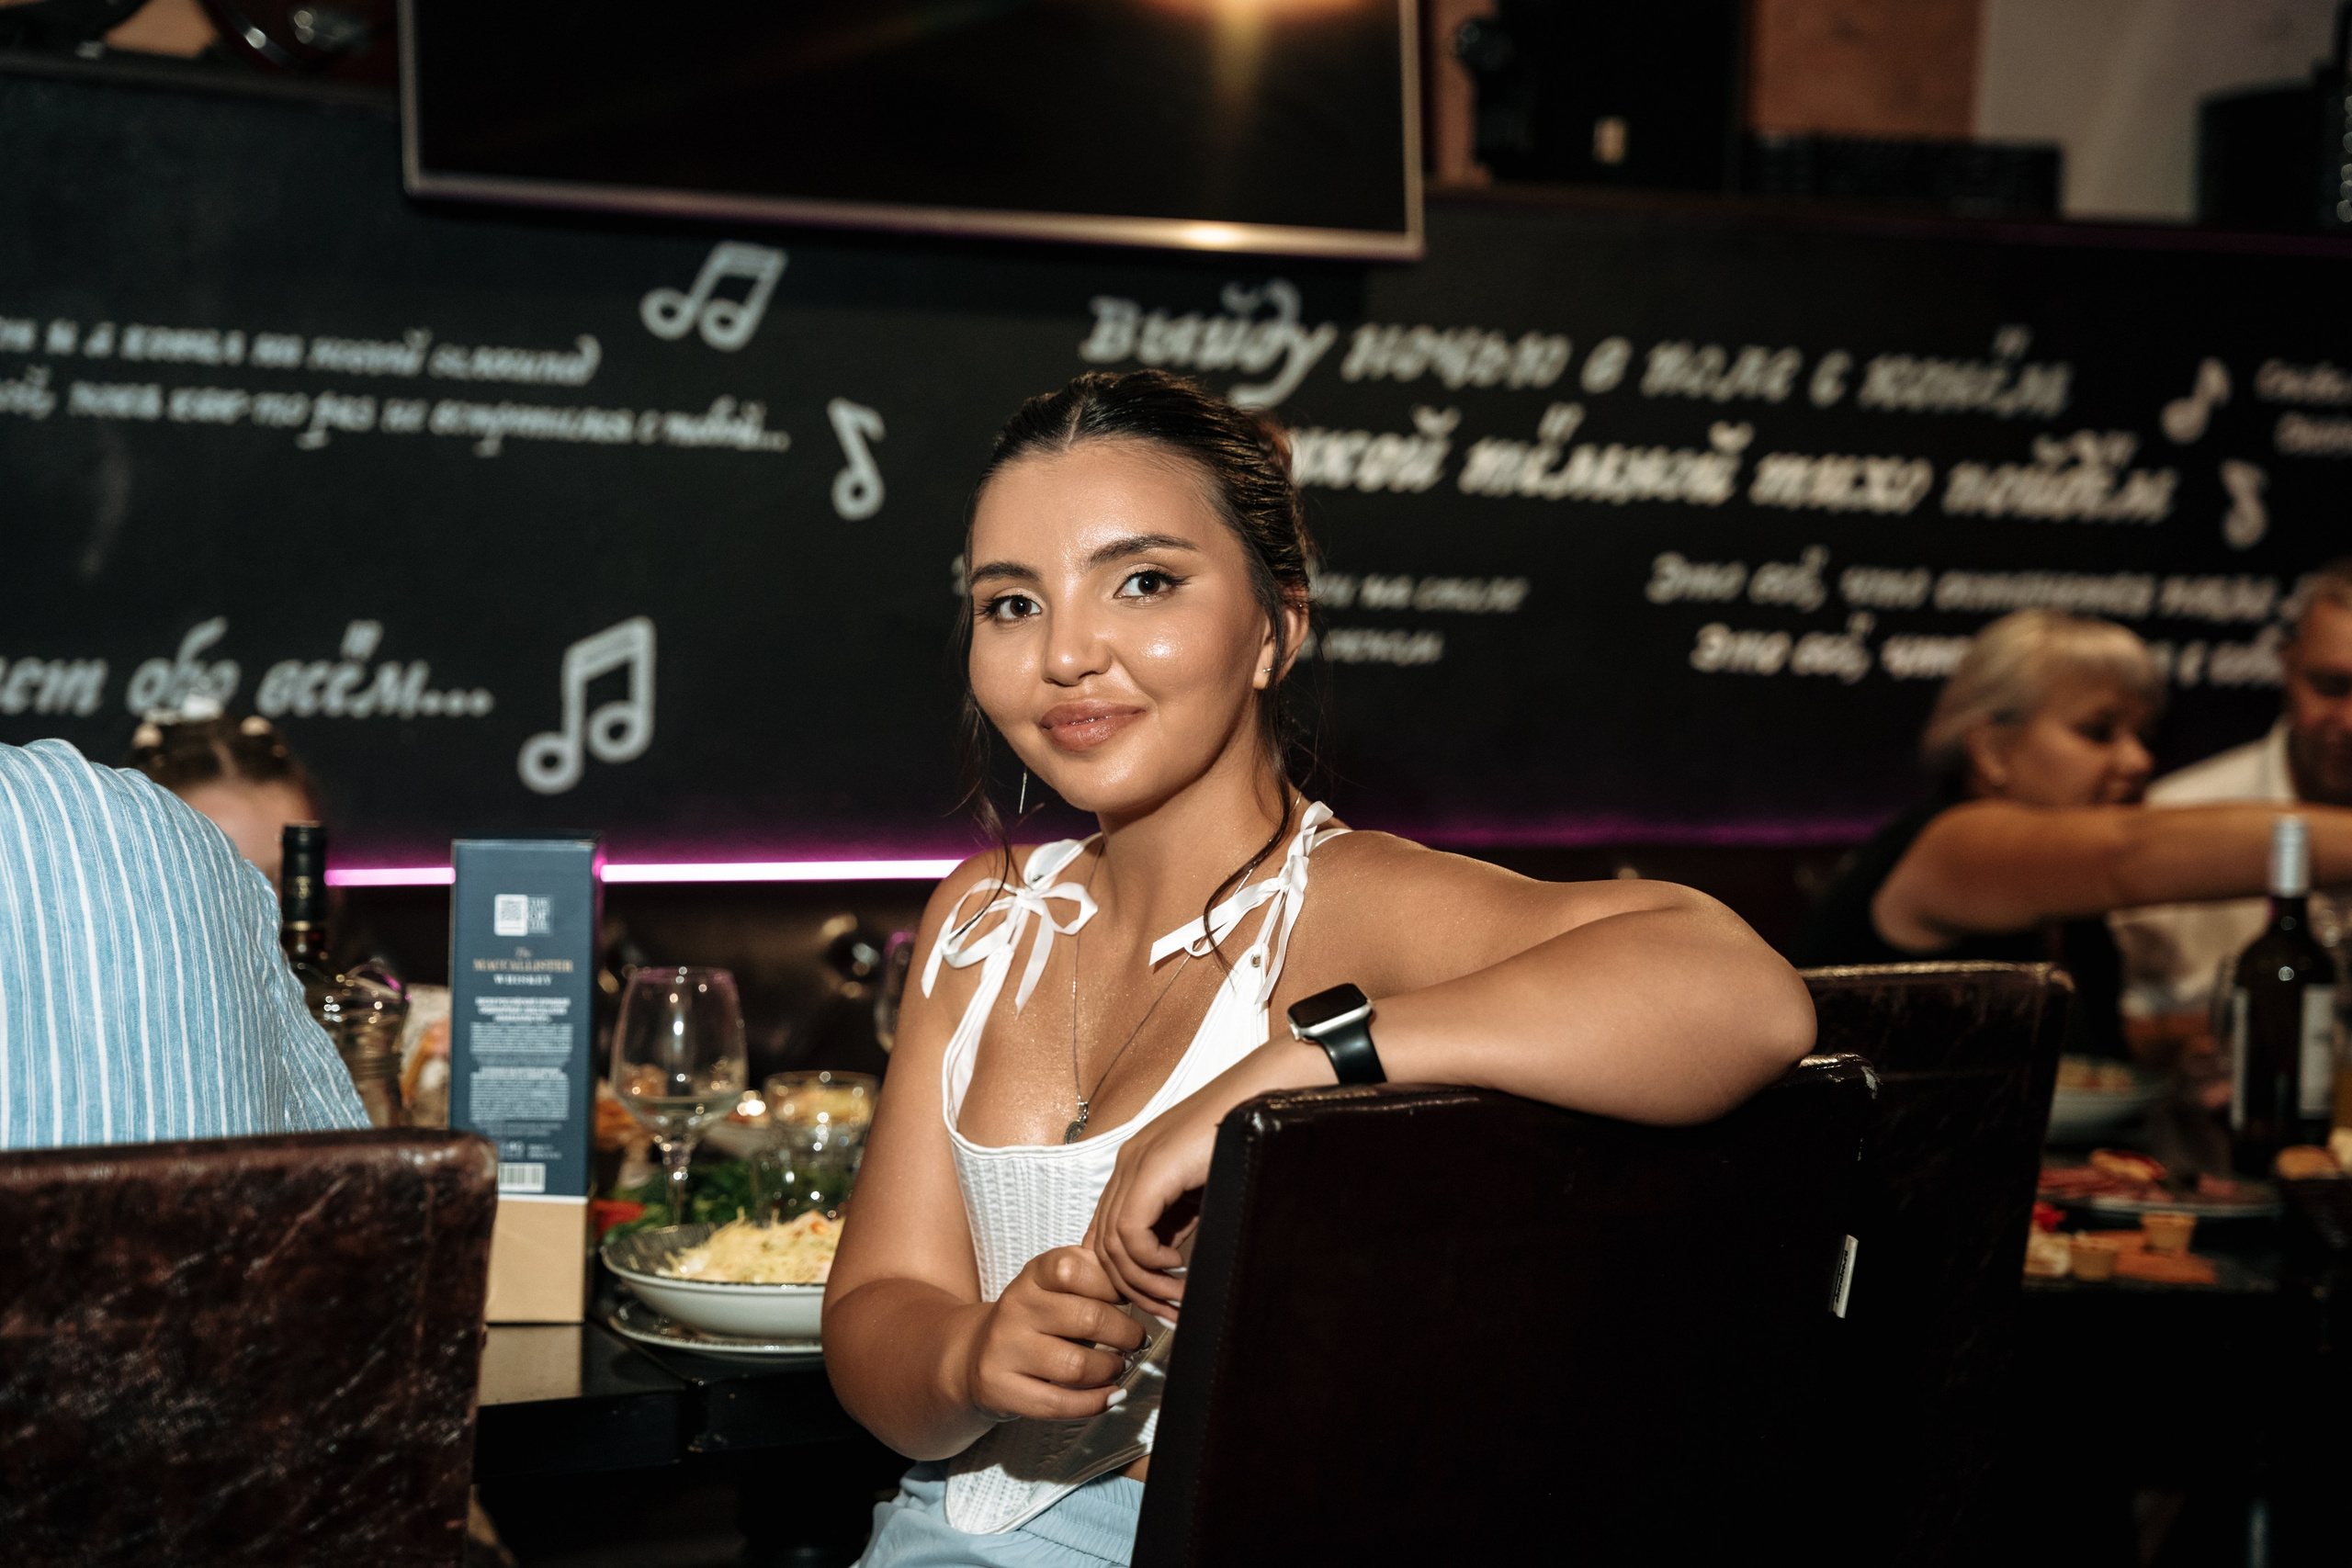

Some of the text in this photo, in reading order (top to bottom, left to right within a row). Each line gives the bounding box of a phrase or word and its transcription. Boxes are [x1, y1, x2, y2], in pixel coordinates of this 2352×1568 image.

[1079, 280, 1338, 408] Выйду
[1340, 322, 1571, 389] ночью
[1579, 335, 1633, 394] в
[1640, 340, 1803, 402] поле
[1808, 349, 1852, 406] с
[1749, 452, 1934, 514] тихо
[1940, 430, 2179, 524] пойдём
[1645, 551, 1747, 604] Это
[0, 655, 107, 716] ет
[255, 619, 494, 717] всём...
[1689, 622, 1792, 676] Это
